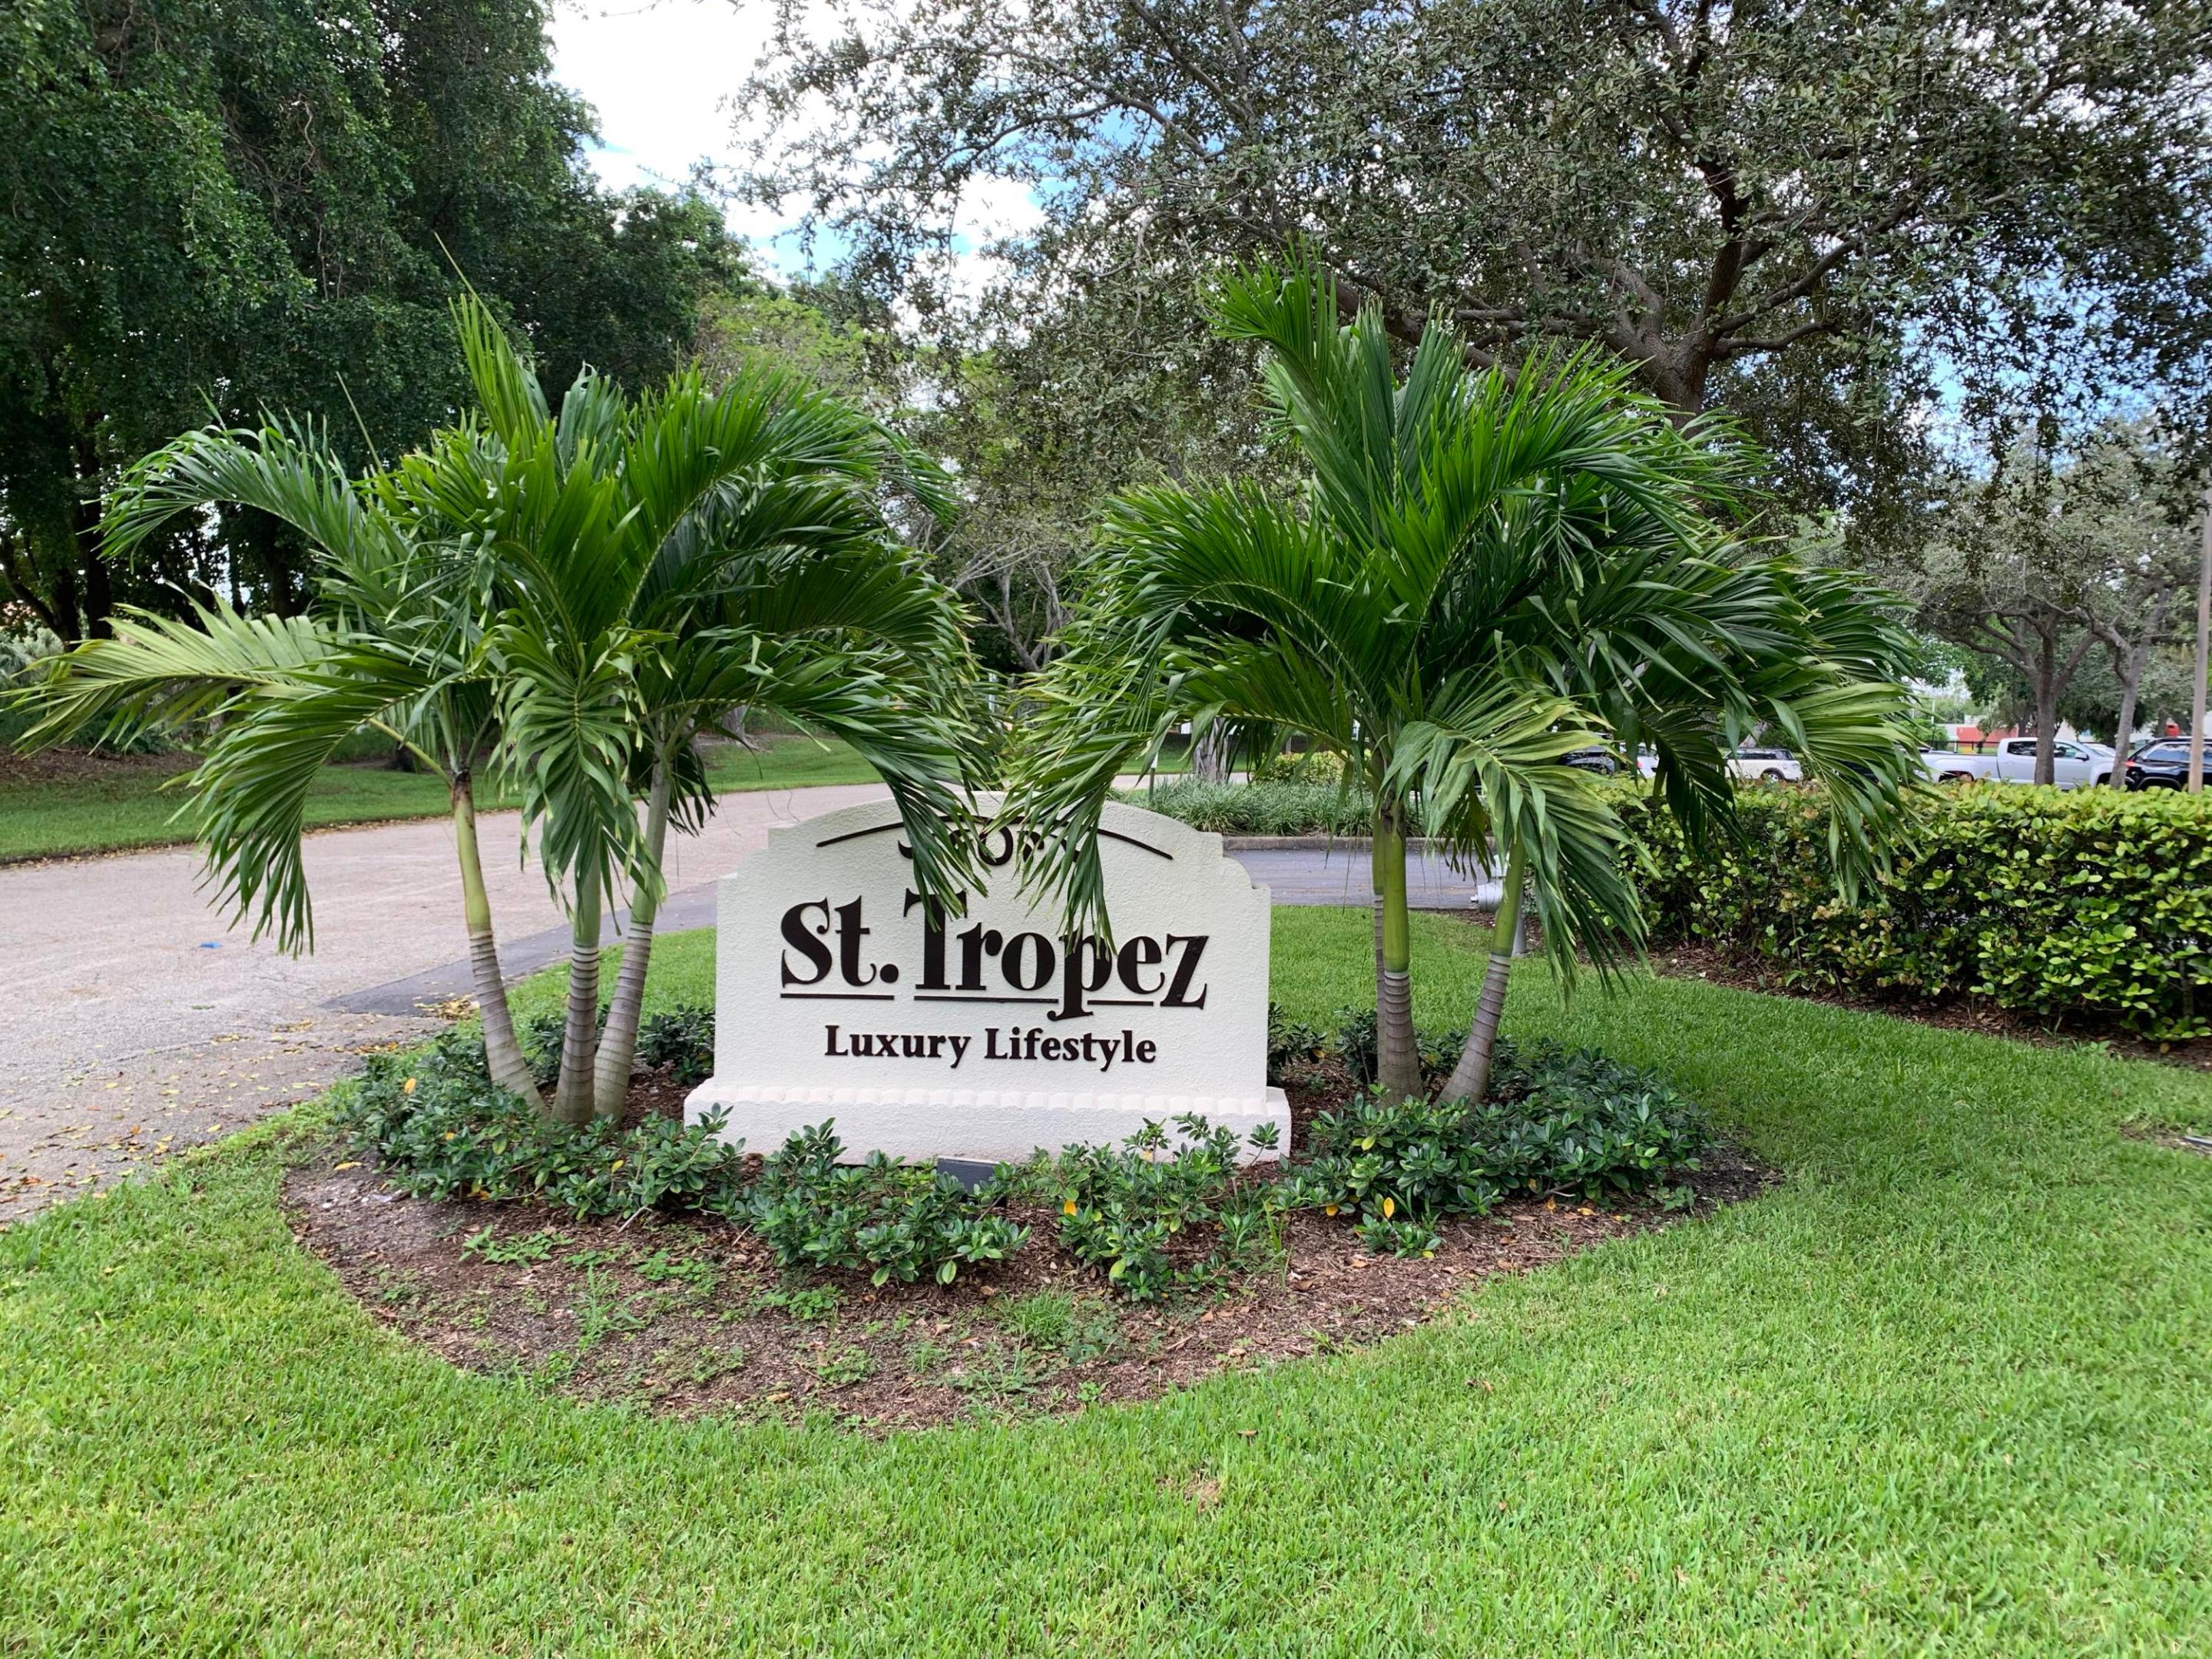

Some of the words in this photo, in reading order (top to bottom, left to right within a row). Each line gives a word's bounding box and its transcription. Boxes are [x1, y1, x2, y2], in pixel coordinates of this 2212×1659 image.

[780, 895, 899, 988] St.
[902, 887, 1210, 1022] Tropez
[824, 1025, 972, 1069] Luxury
[984, 1028, 1157, 1072] Lifestyle
